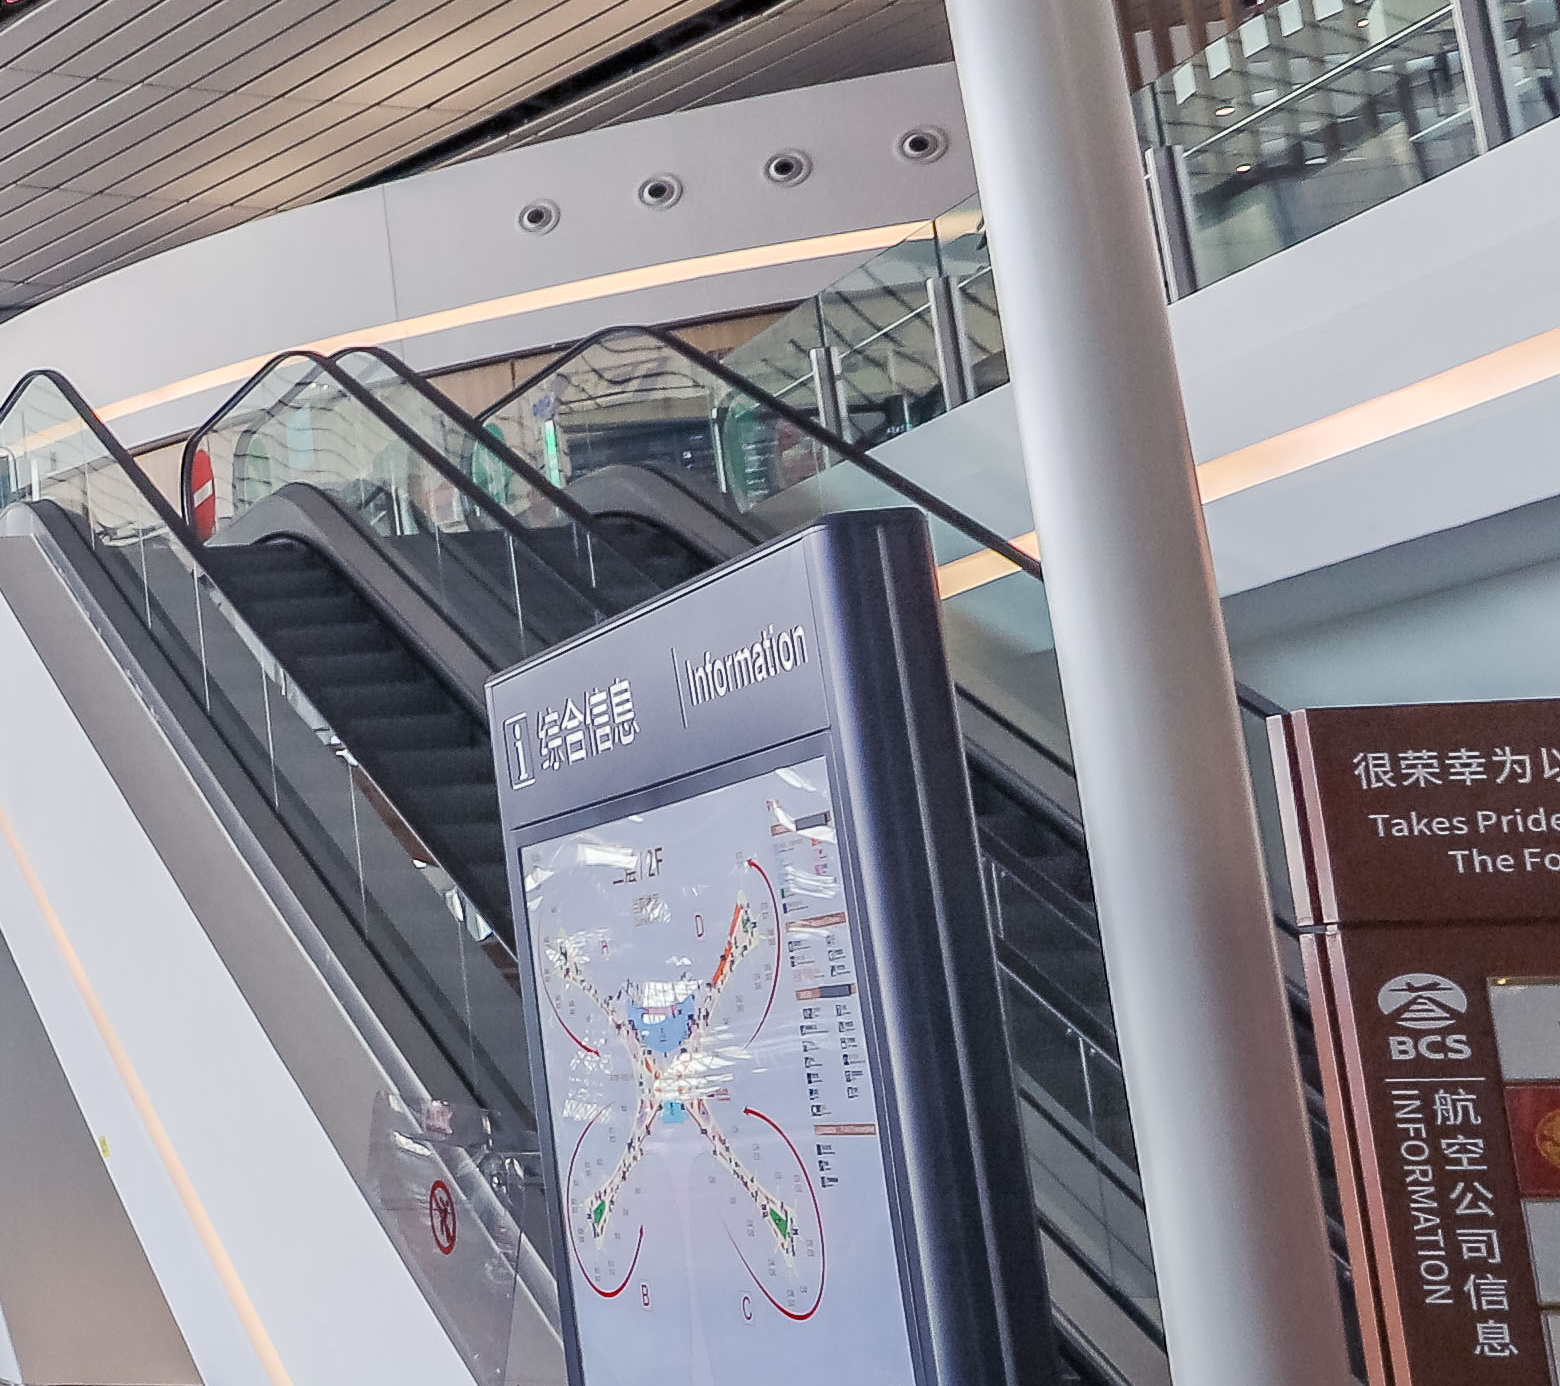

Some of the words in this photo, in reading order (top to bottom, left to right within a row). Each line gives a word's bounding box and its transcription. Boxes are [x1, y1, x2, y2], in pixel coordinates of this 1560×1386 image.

[685, 623, 809, 706] Information
[537, 677, 640, 771] 综合信息
[1369, 812, 1469, 839] Takes
[645, 846, 663, 877] 2F
[1447, 847, 1515, 874] The
[1388, 1034, 1472, 1060] BCS
[1389, 1088, 1455, 1306] INFORMATION
[1432, 1086, 1520, 1358] 航空公司信息
[641, 1284, 650, 1307] B
[742, 1296, 753, 1321] C
